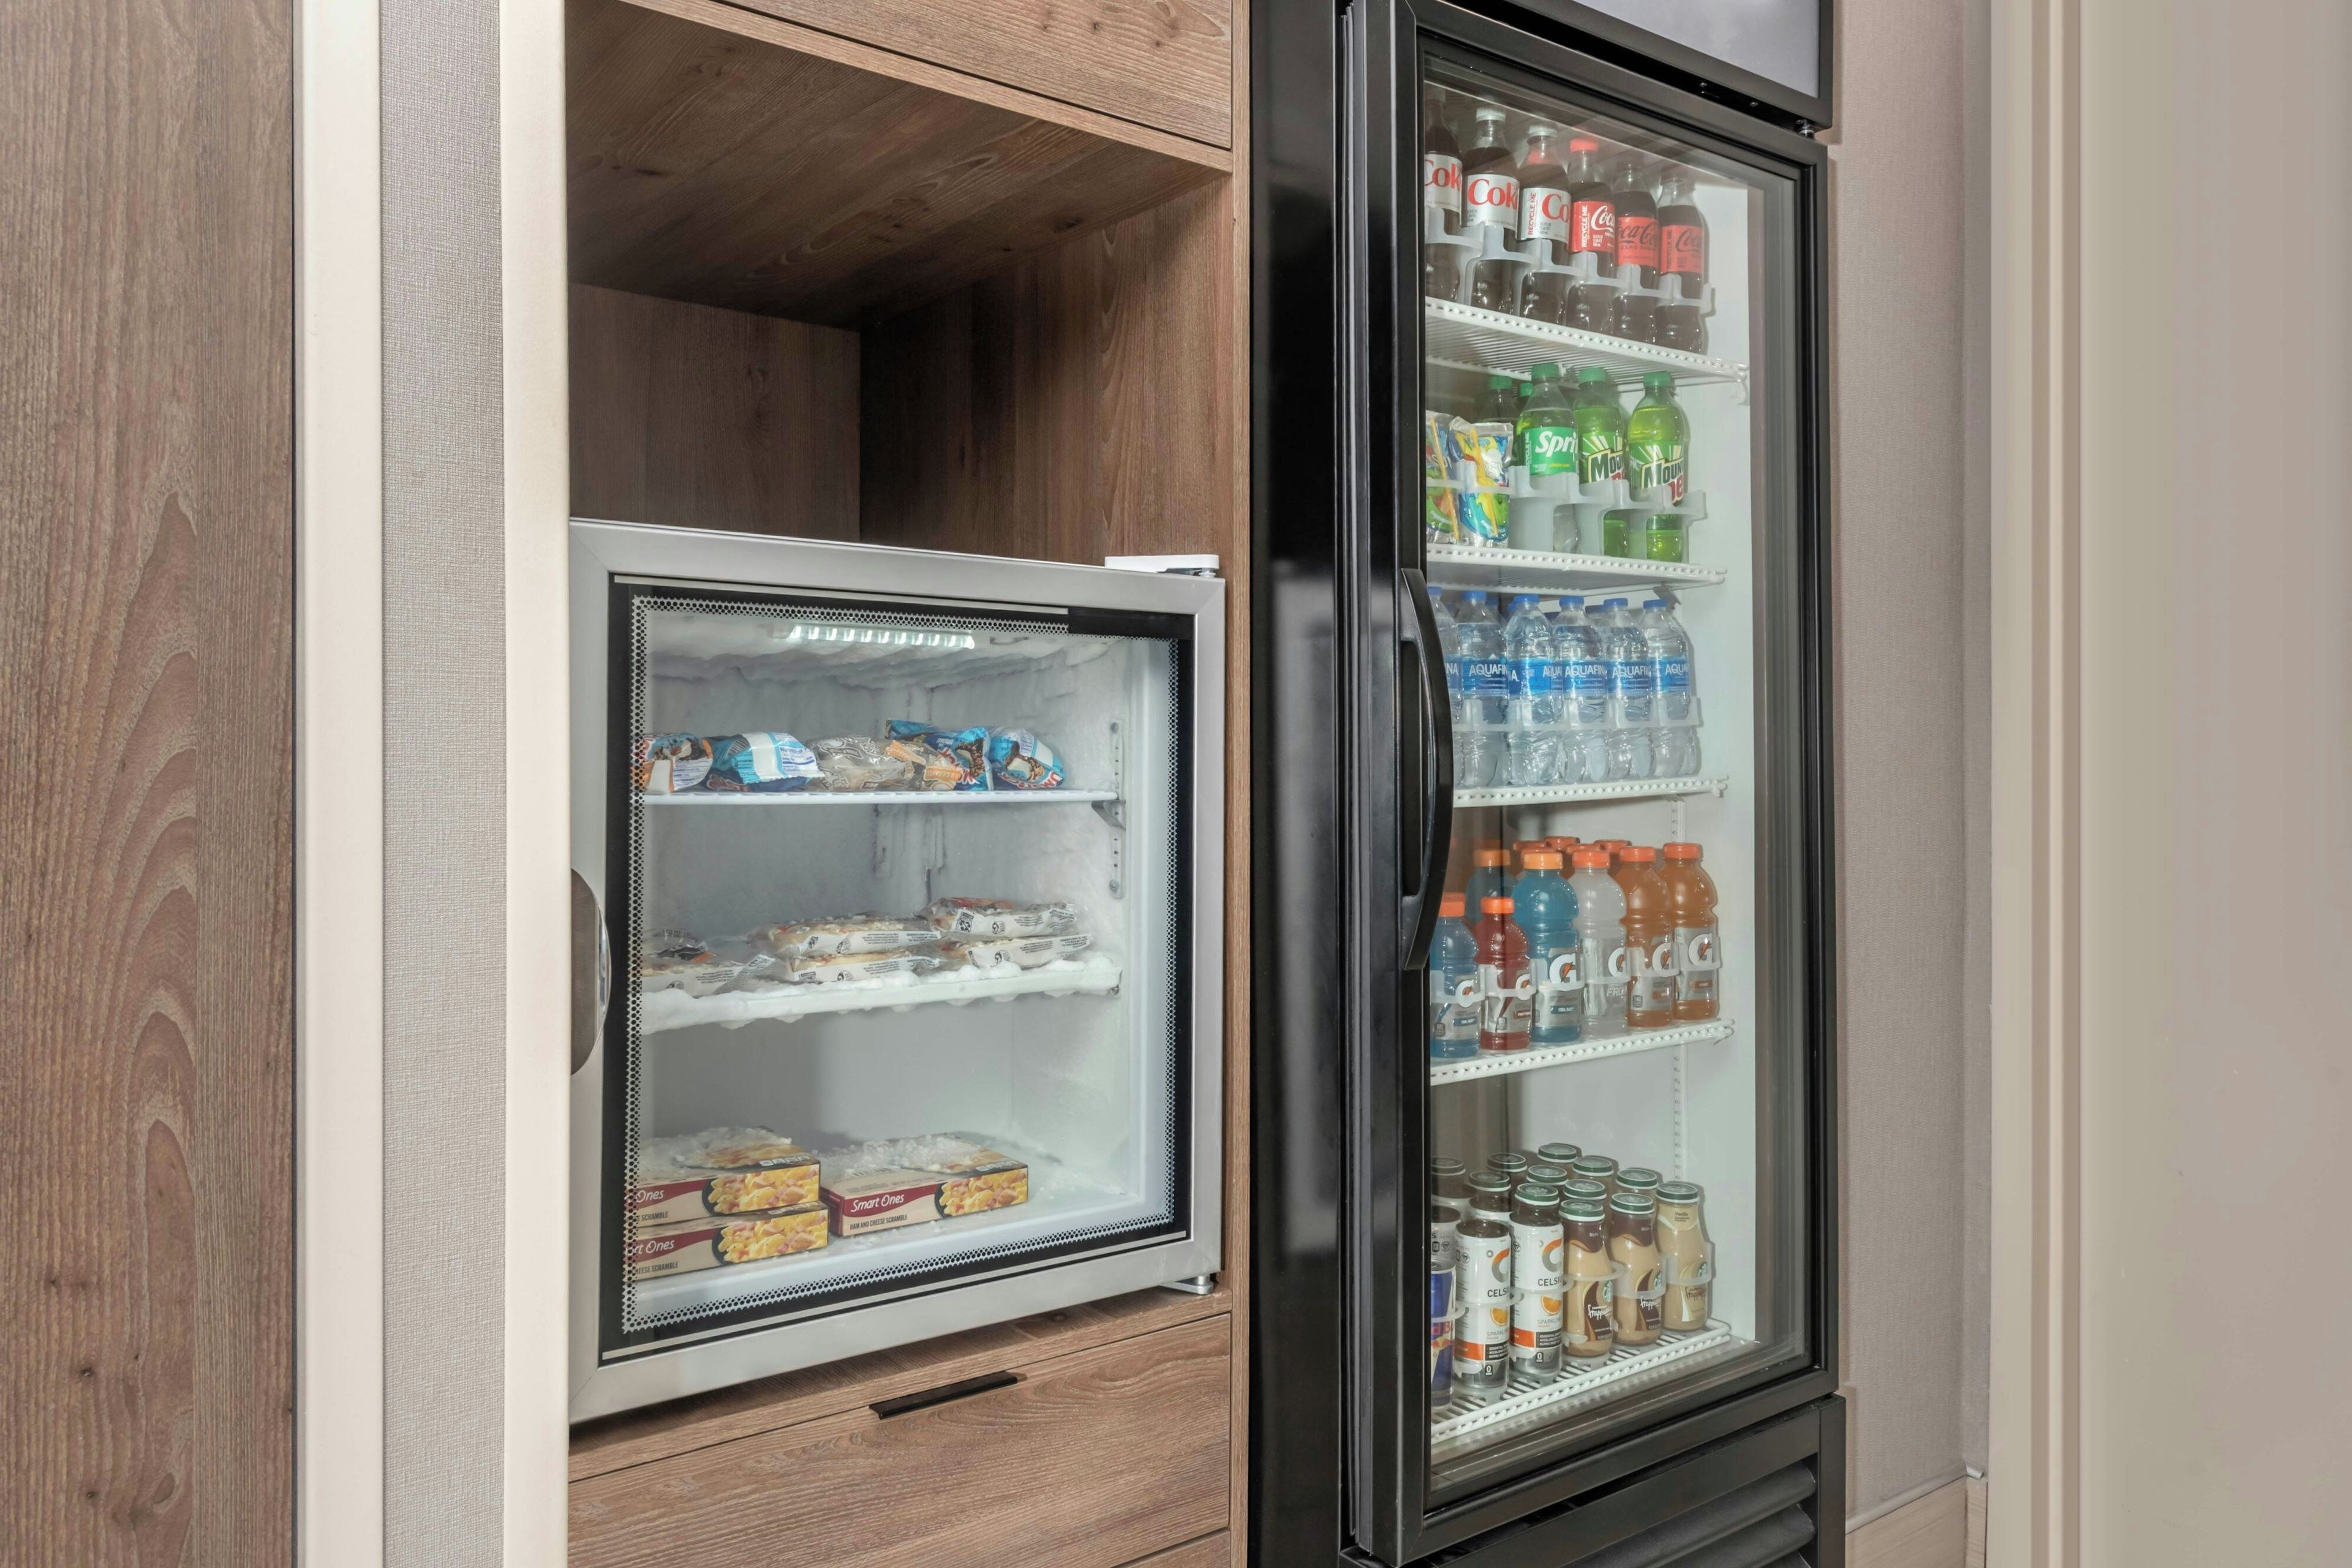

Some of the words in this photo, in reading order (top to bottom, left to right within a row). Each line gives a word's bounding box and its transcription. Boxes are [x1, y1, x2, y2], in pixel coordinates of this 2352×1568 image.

[1531, 192, 1536, 202] ME
[1581, 205, 1588, 215] ME
[1687, 933, 1713, 967] G
[1608, 946, 1628, 982] G
[1652, 942, 1674, 978] G
[1549, 953, 1577, 992] G
[1455, 979, 1475, 1008] G
[1515, 973, 1532, 1001] G
[635, 1189, 665, 1203] Ones
[850, 1197, 880, 1213] Smart
[881, 1194, 905, 1207] Ones
[641, 1211, 669, 1221] SCRAMBLE
[850, 1222, 861, 1231] HAM
[870, 1218, 886, 1227] CHEESE
[886, 1213, 908, 1224] SCRAMBLE
[646, 1240, 675, 1254] Ones
[651, 1261, 679, 1272] SCRAMBLE
